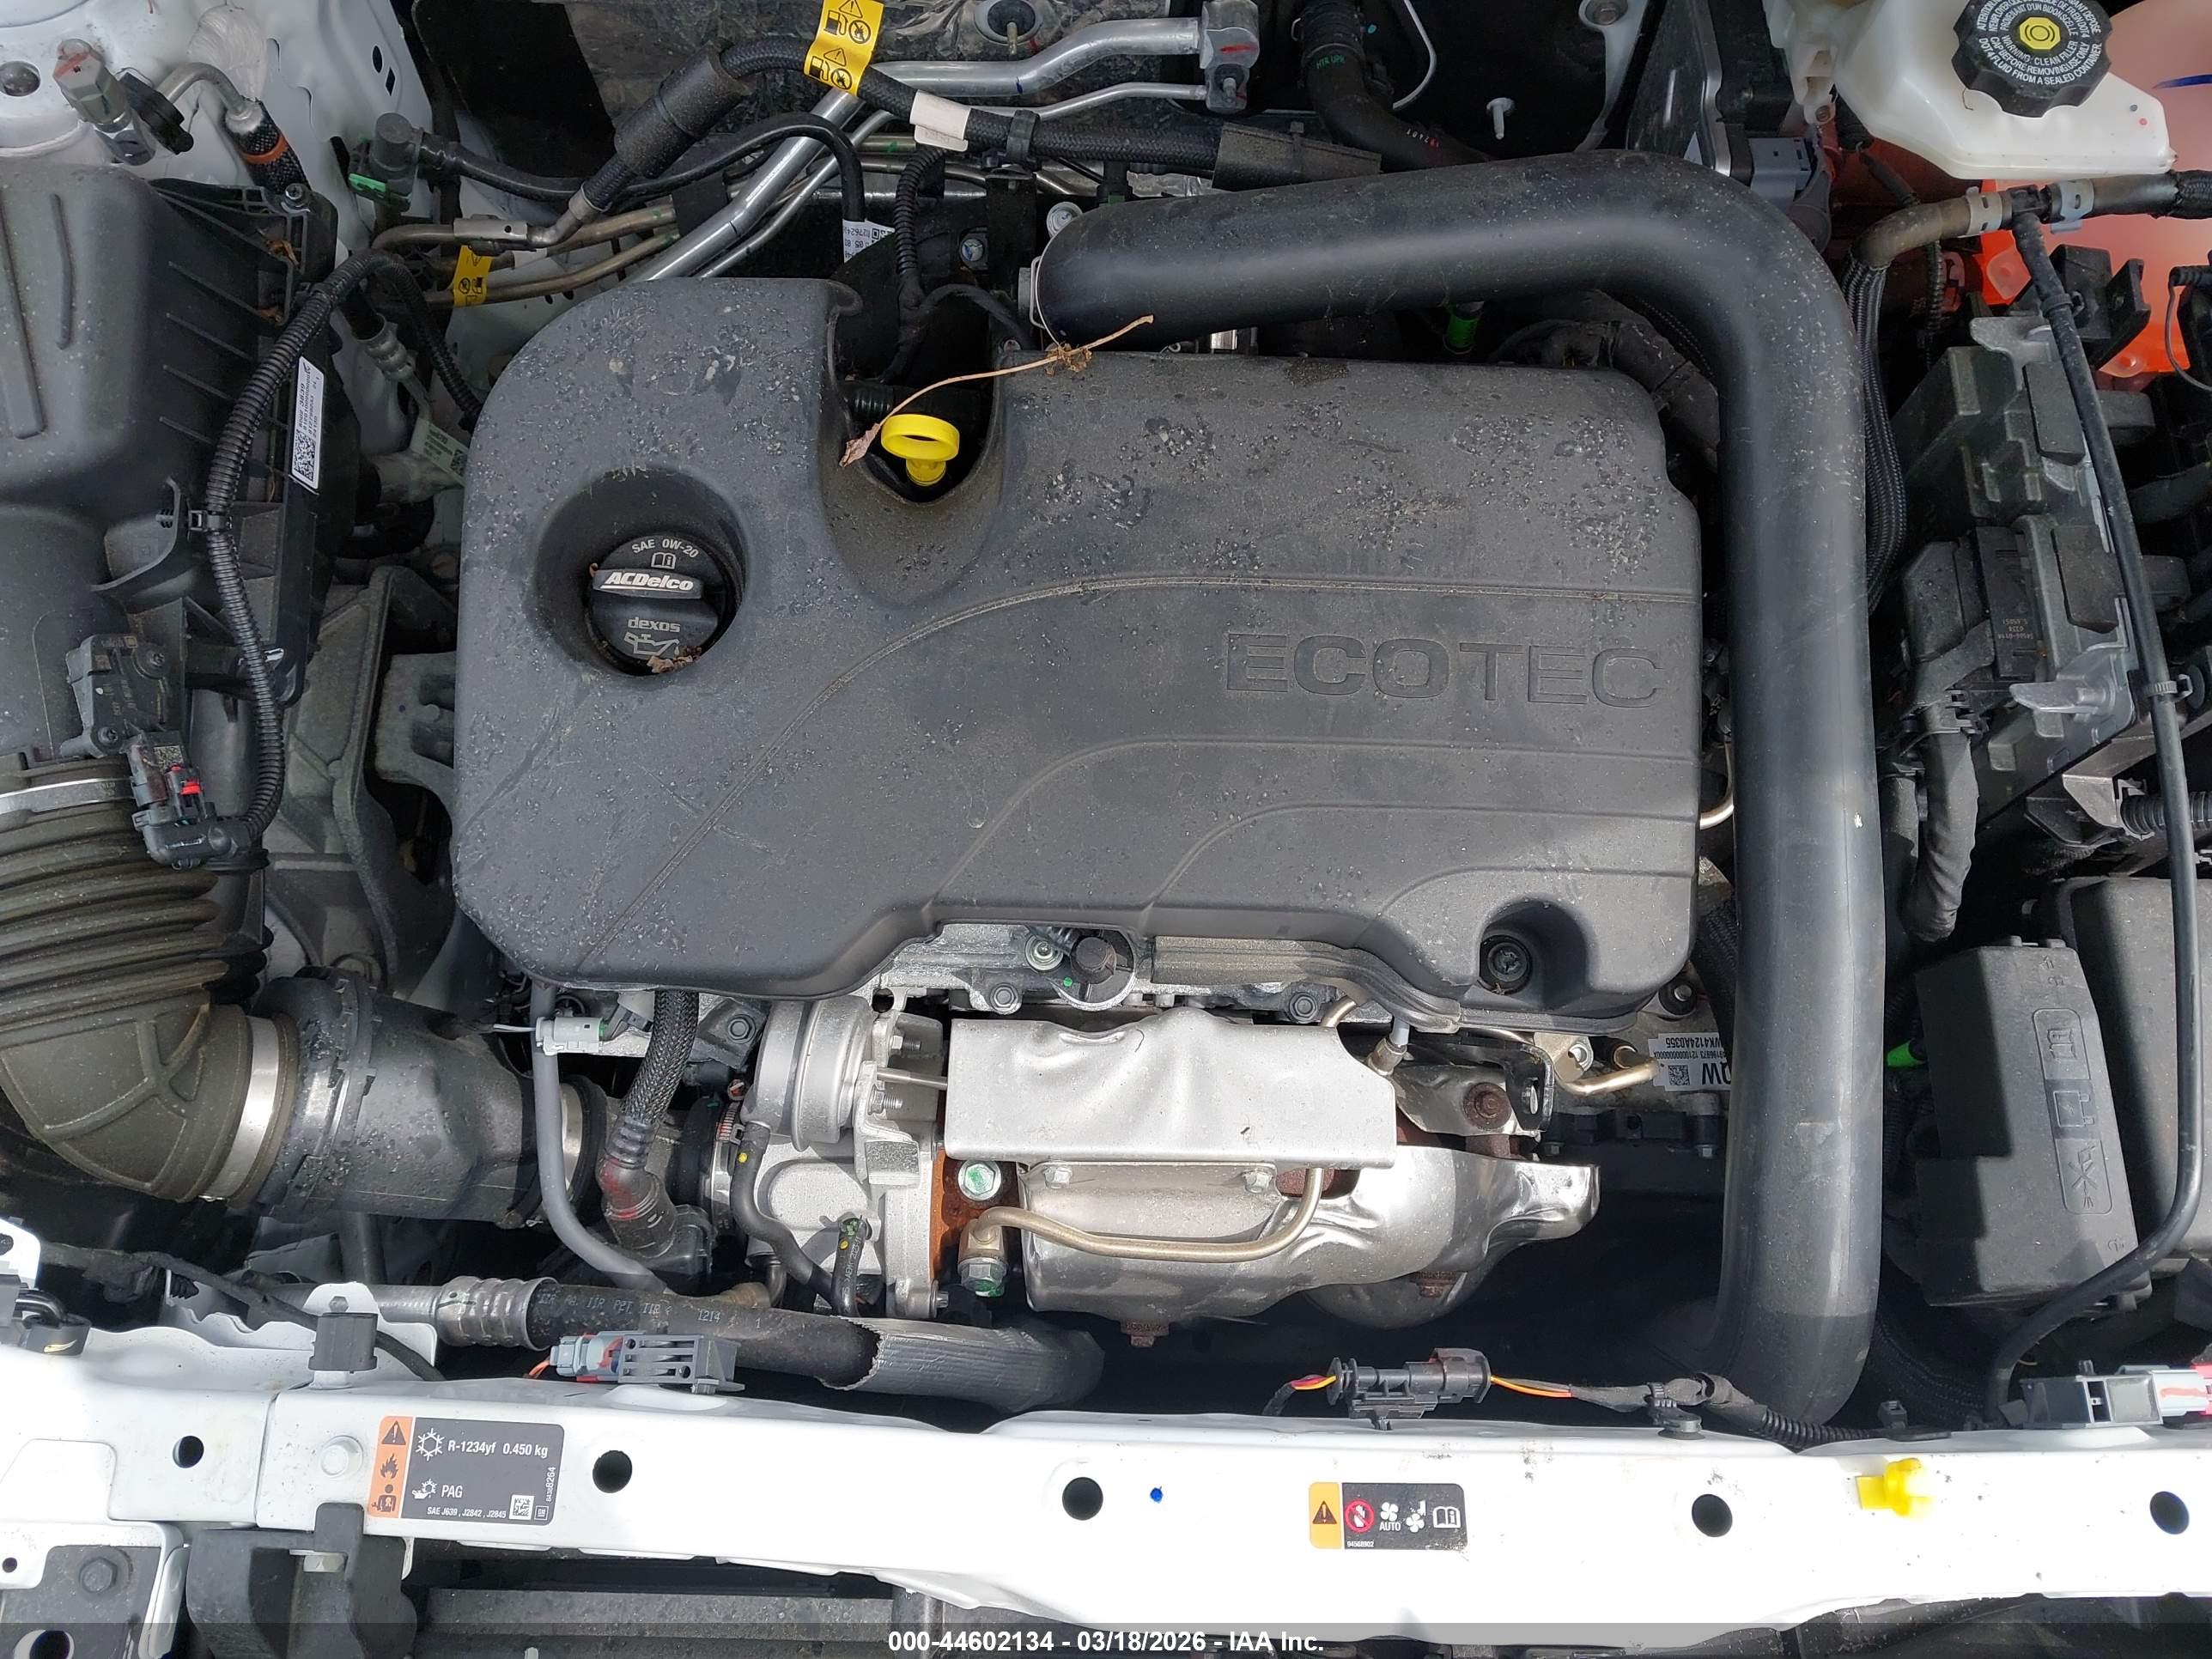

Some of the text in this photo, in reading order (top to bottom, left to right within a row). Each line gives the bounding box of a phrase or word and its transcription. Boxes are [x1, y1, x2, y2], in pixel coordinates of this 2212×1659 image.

[2043, 3, 2063, 18] BIDON
[2065, 6, 2085, 23] FREIN
[1990, 36, 2003, 50] CAP
[1998, 49, 2027, 71] BEFORE
[2067, 57, 2081, 70] USE
[2076, 41, 2090, 59] ONLY
[2033, 55, 2061, 66] CLEAN
[2058, 40, 2078, 61] FILLER
[1990, 55, 2013, 74] FLUID
[2011, 70, 2036, 83] FROM
[2036, 76, 2044, 85] A
[2044, 72, 2075, 85] SEALED
[632, 538, 699, 558] SAE 0W-20
[605, 572, 694, 591] ACDelco
[628, 617, 681, 633] dexos
[1227, 633, 1662, 708] ECOTEC
[447, 1440, 549, 1459] R-1234yf 0.450 kg
[441, 1485, 464, 1498] PAG
[427, 1506, 441, 1516] SAE
[441, 1508, 458, 1516] J639
[462, 1509, 482, 1517] J2842
[1379, 1521, 1401, 1532] AUTO
